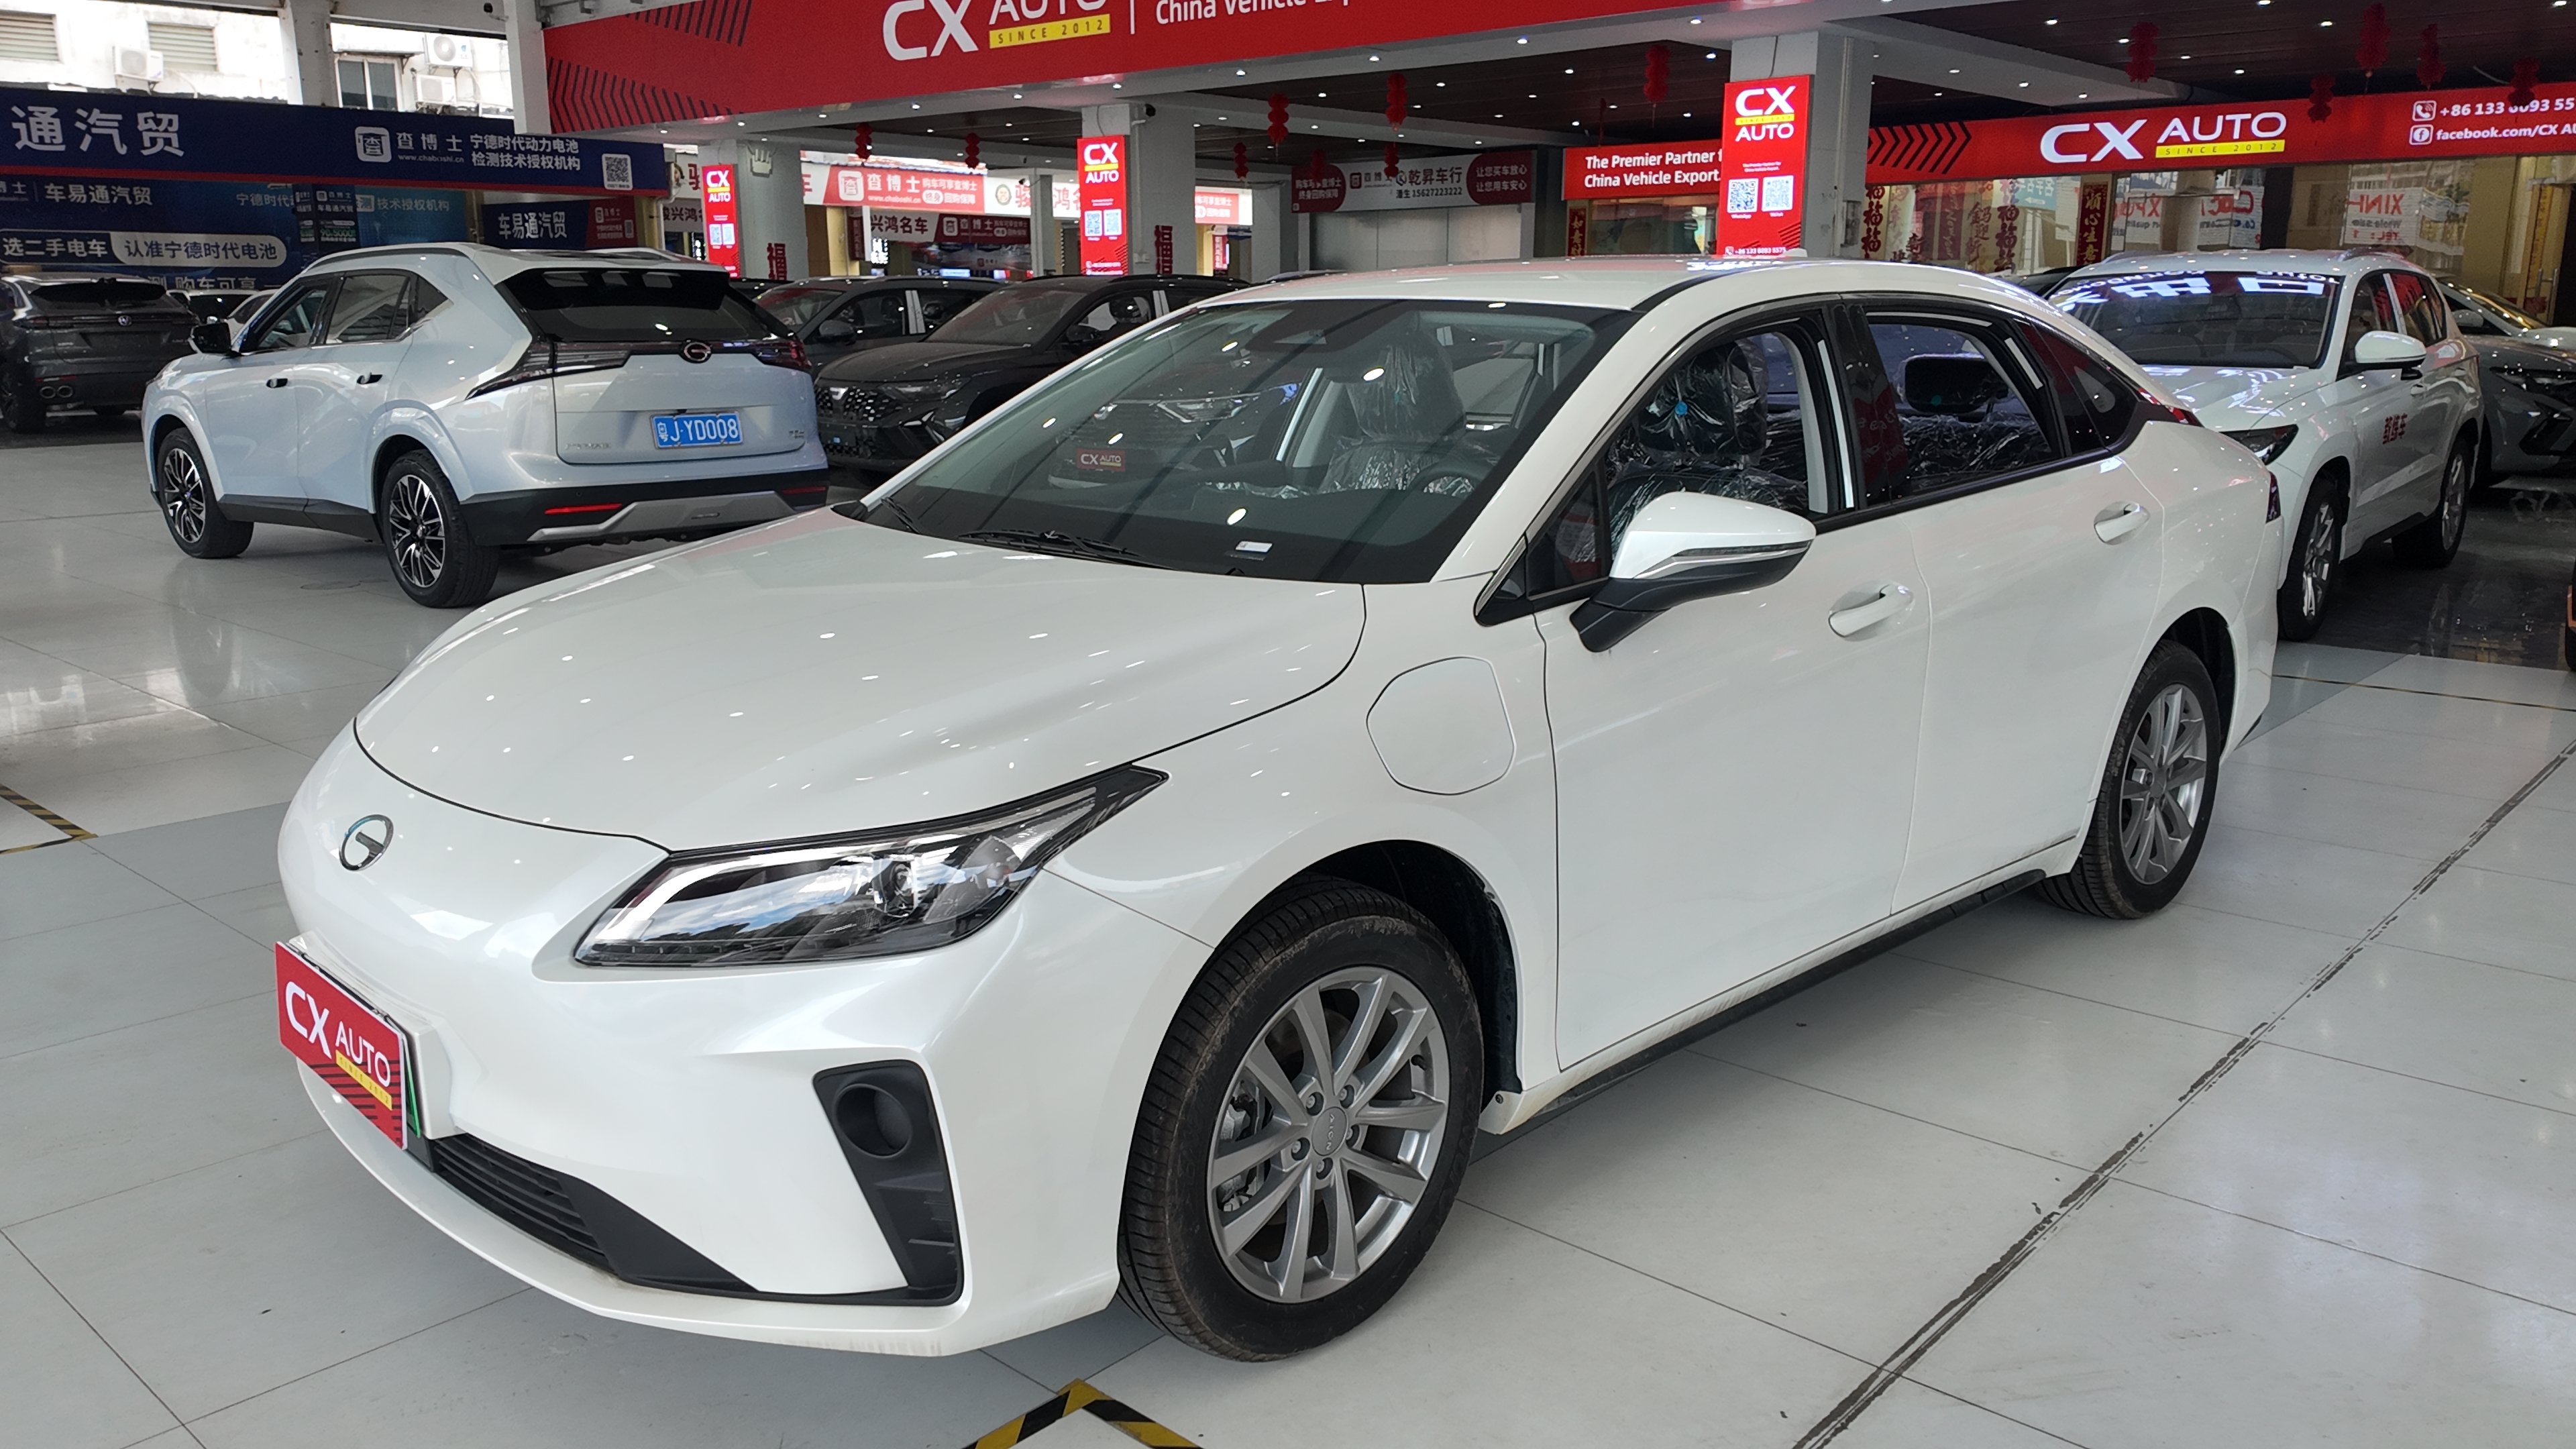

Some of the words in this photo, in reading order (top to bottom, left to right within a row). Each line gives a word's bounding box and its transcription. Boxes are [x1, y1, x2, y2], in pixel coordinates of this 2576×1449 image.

[1156, 0, 1217, 25] China
[883, 0, 979, 61] CX
[989, 0, 1107, 25] AU
[998, 29, 1048, 44] SINCE
[1061, 19, 1104, 36] 2012
[1735, 86, 1796, 117] CX
[2440, 104, 2471, 117] +86
[2474, 102, 2505, 115] 133
[2554, 97, 2576, 111] 55
[11, 105, 184, 157] 通汽贸
[1735, 123, 1794, 142] AUTO
[2040, 119, 2147, 164] CX
[2157, 112, 2287, 144] AUTO
[2436, 123, 2559, 141] facebook.com/CX
[396, 132, 463, 152] 查博士
[470, 134, 579, 154] 宁德时代动力电池
[2165, 146, 2217, 155] SINCE
[2233, 143, 2277, 152] 2012
[472, 152, 581, 170] 检测技术授权机构
[1084, 142, 1119, 165] CX
[1585, 156, 1609, 169] The
[1611, 153, 1663, 168] Premier
[1665, 151, 1715, 165] Partner
[706, 170, 730, 188] CX
[1085, 170, 1120, 184] AUTO
[1584, 173, 1621, 188] China
[1623, 170, 1671, 186] Vehicle
[1674, 168, 1721, 186] Export.
[44, 182, 153, 205] 车易通汽贸
[708, 192, 731, 203] AUTO
[498, 211, 567, 239] 车易通汽贸
[871, 215, 928, 235] 兴鸿名车
[3, 237, 108, 257] 选二手电车
[125, 240, 277, 260] 认准宁德时代电池
[1081, 453, 1099, 465] CX
[286, 981, 332, 1059] CX
[335, 1021, 390, 1087] AUTO
